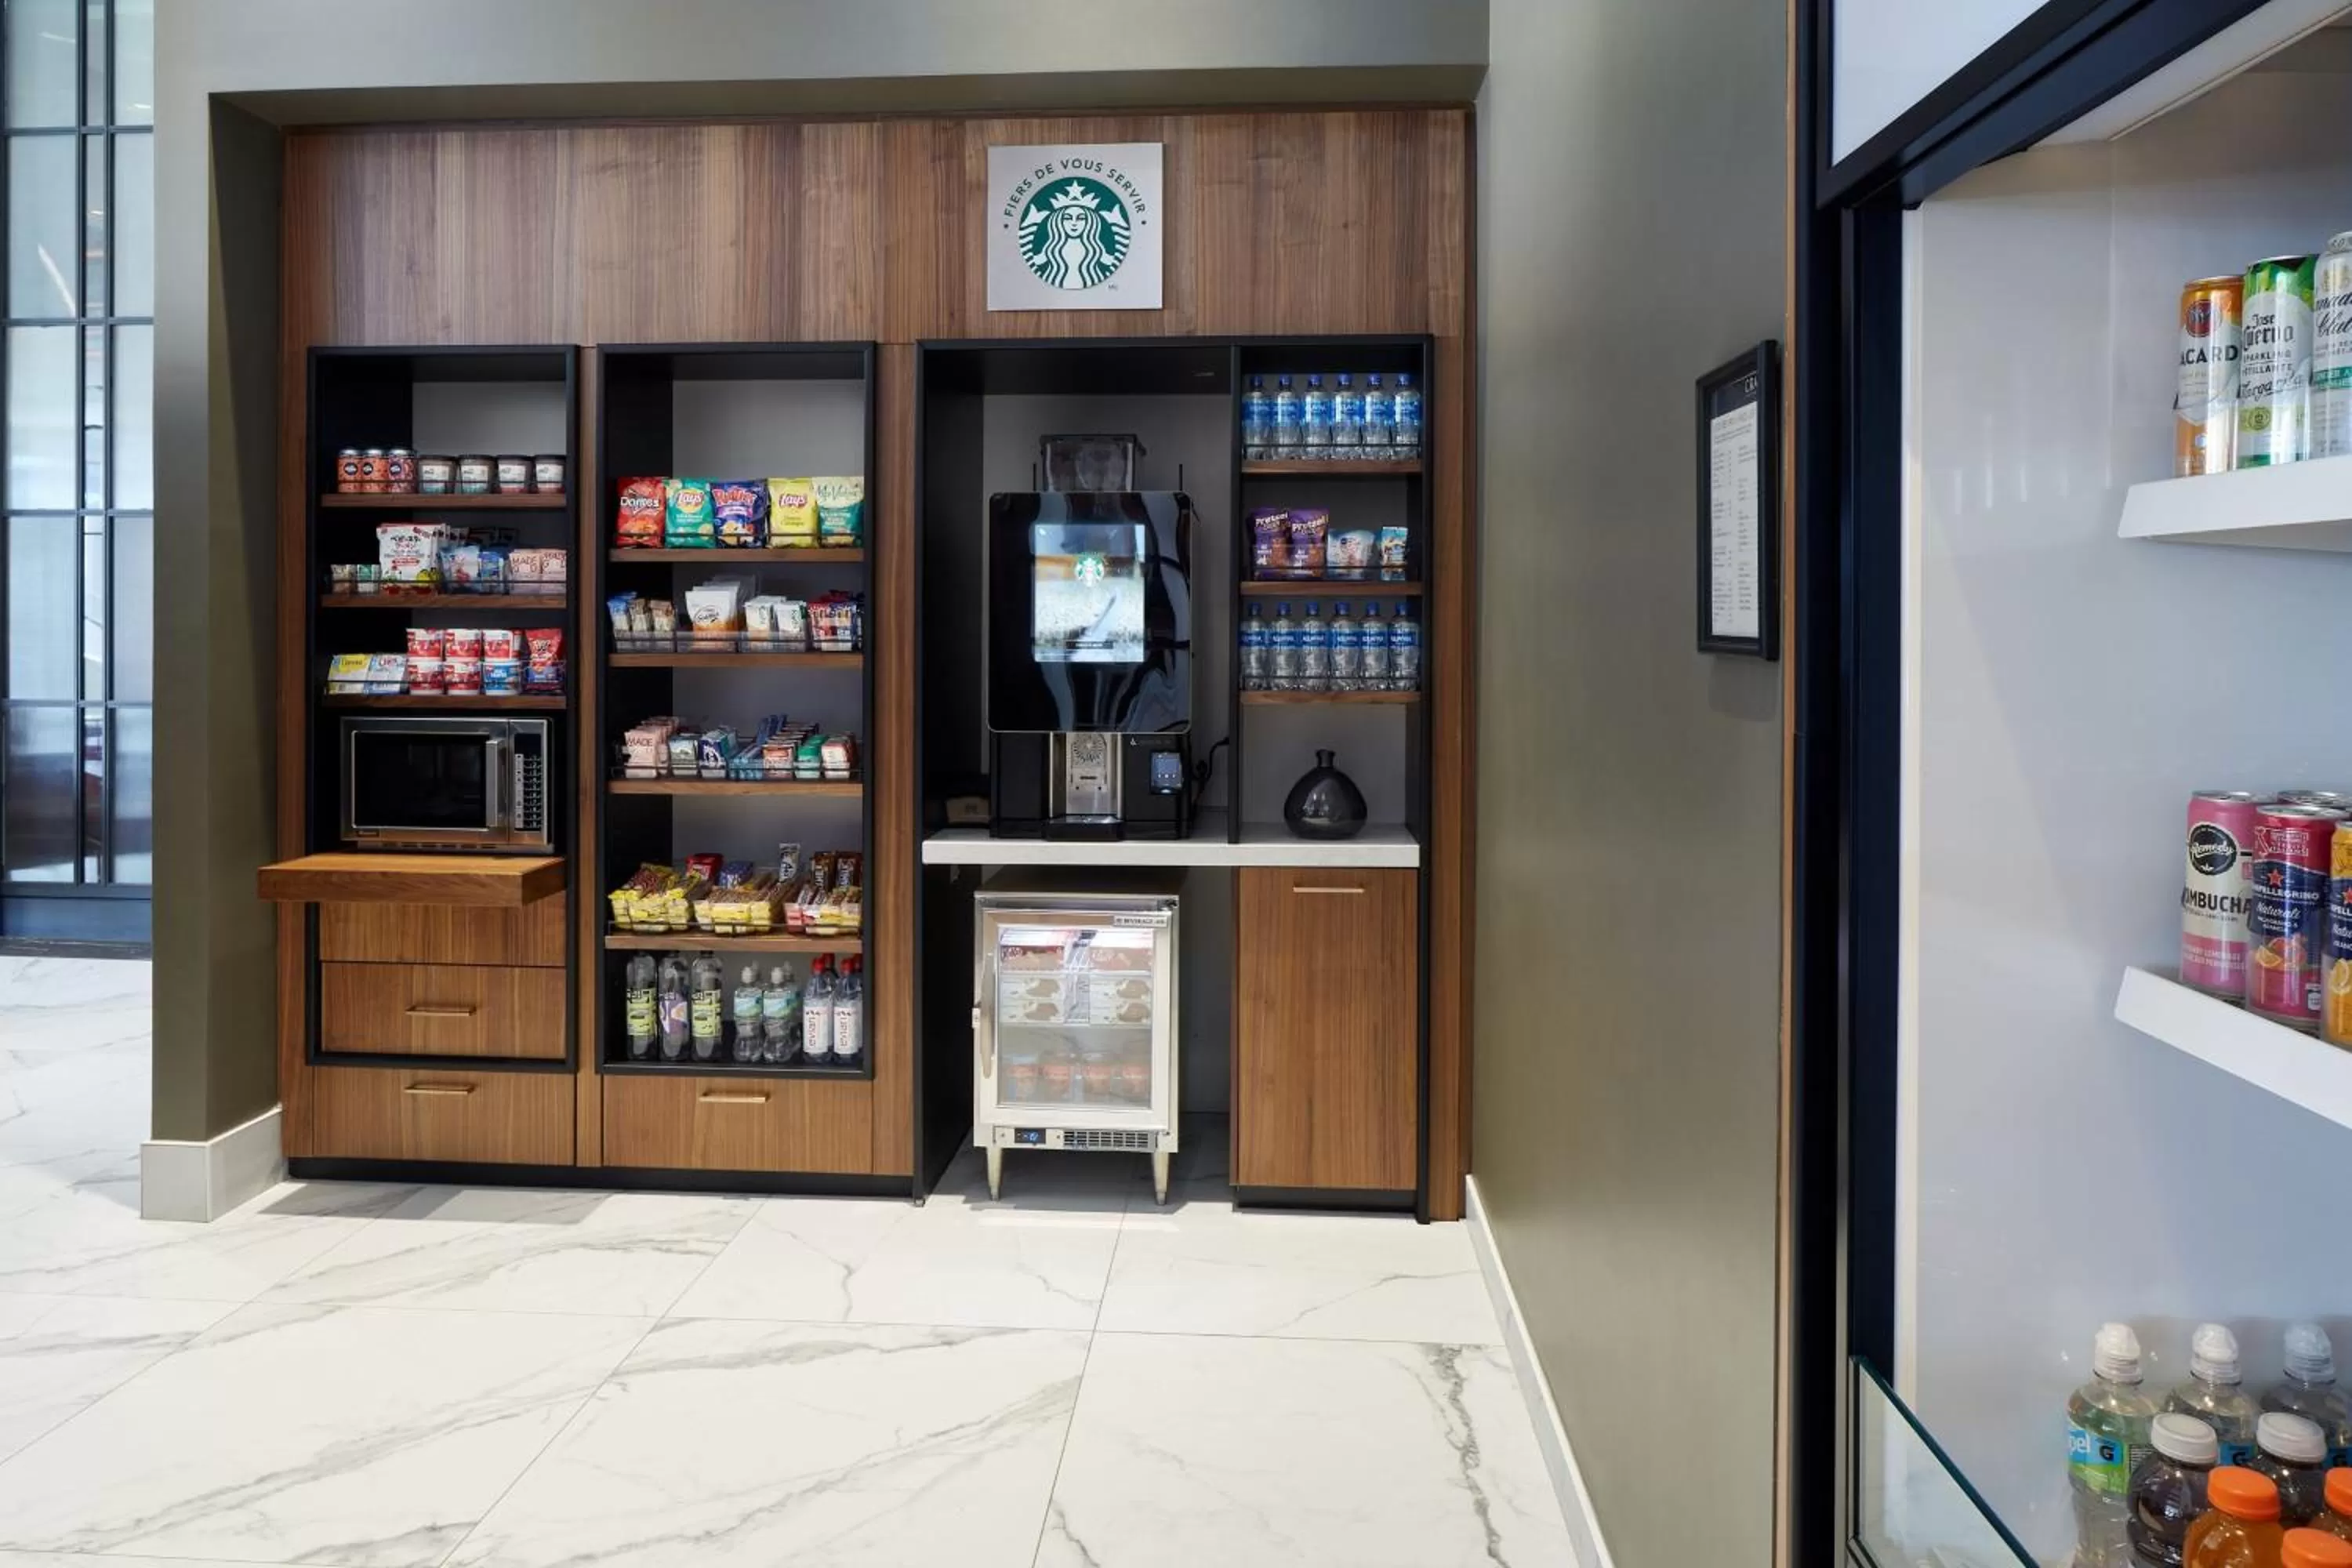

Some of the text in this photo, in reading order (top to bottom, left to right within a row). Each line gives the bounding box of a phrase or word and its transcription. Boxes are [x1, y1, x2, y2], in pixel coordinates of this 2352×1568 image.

[1004, 158, 1146, 217] FIERS DE VOUS SERVIR
[2179, 344, 2238, 365] ACARD
[2190, 840, 2234, 859] Remedy
[2183, 887, 2252, 914] OMBUCHA
